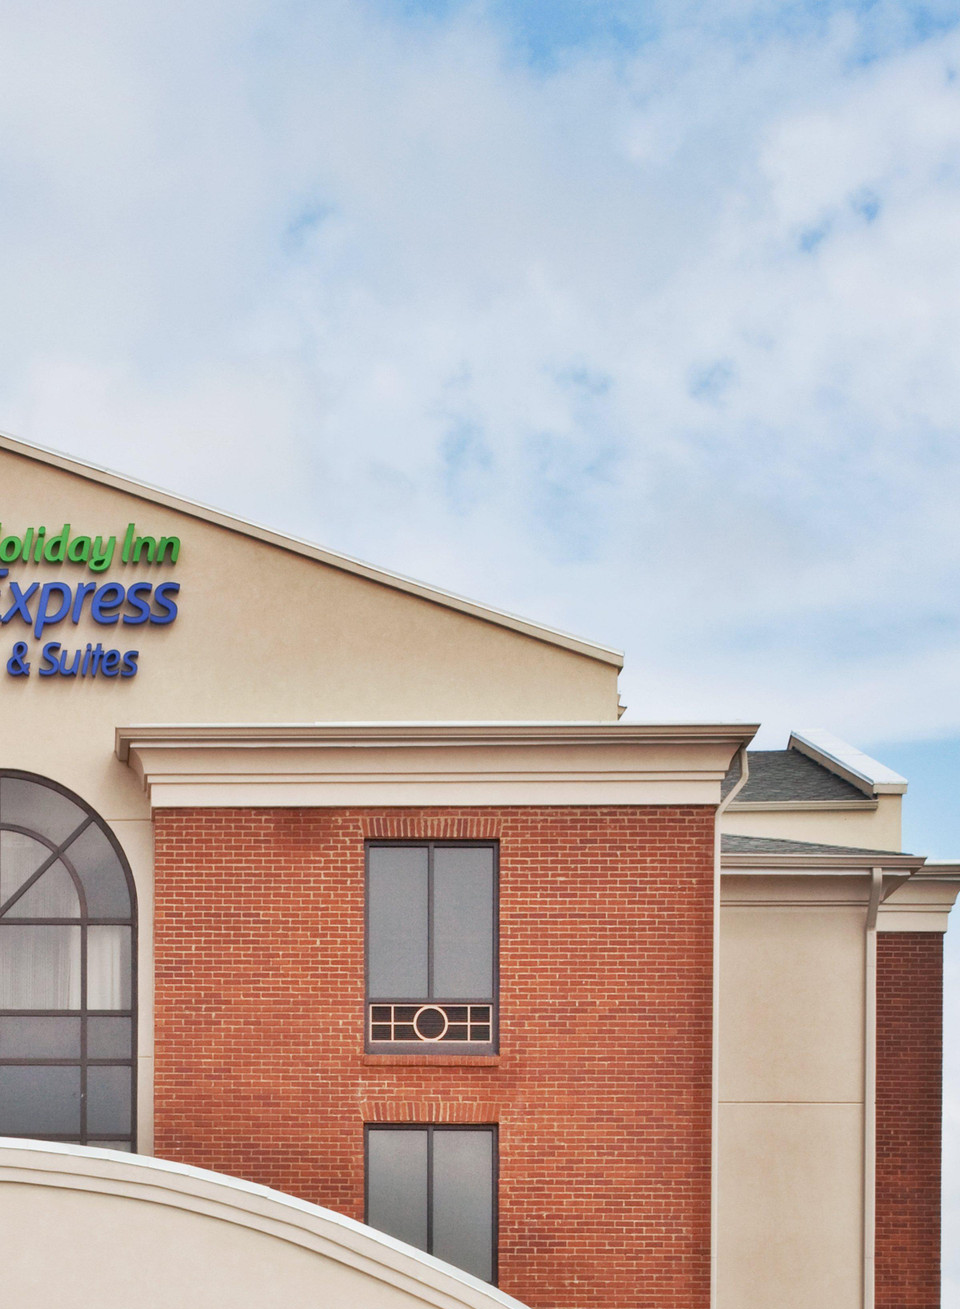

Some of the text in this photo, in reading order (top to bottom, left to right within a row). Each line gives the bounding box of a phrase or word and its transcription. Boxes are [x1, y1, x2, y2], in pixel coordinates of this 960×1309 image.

[122, 523, 180, 563] Inn
[6, 641, 139, 678] & Suites
